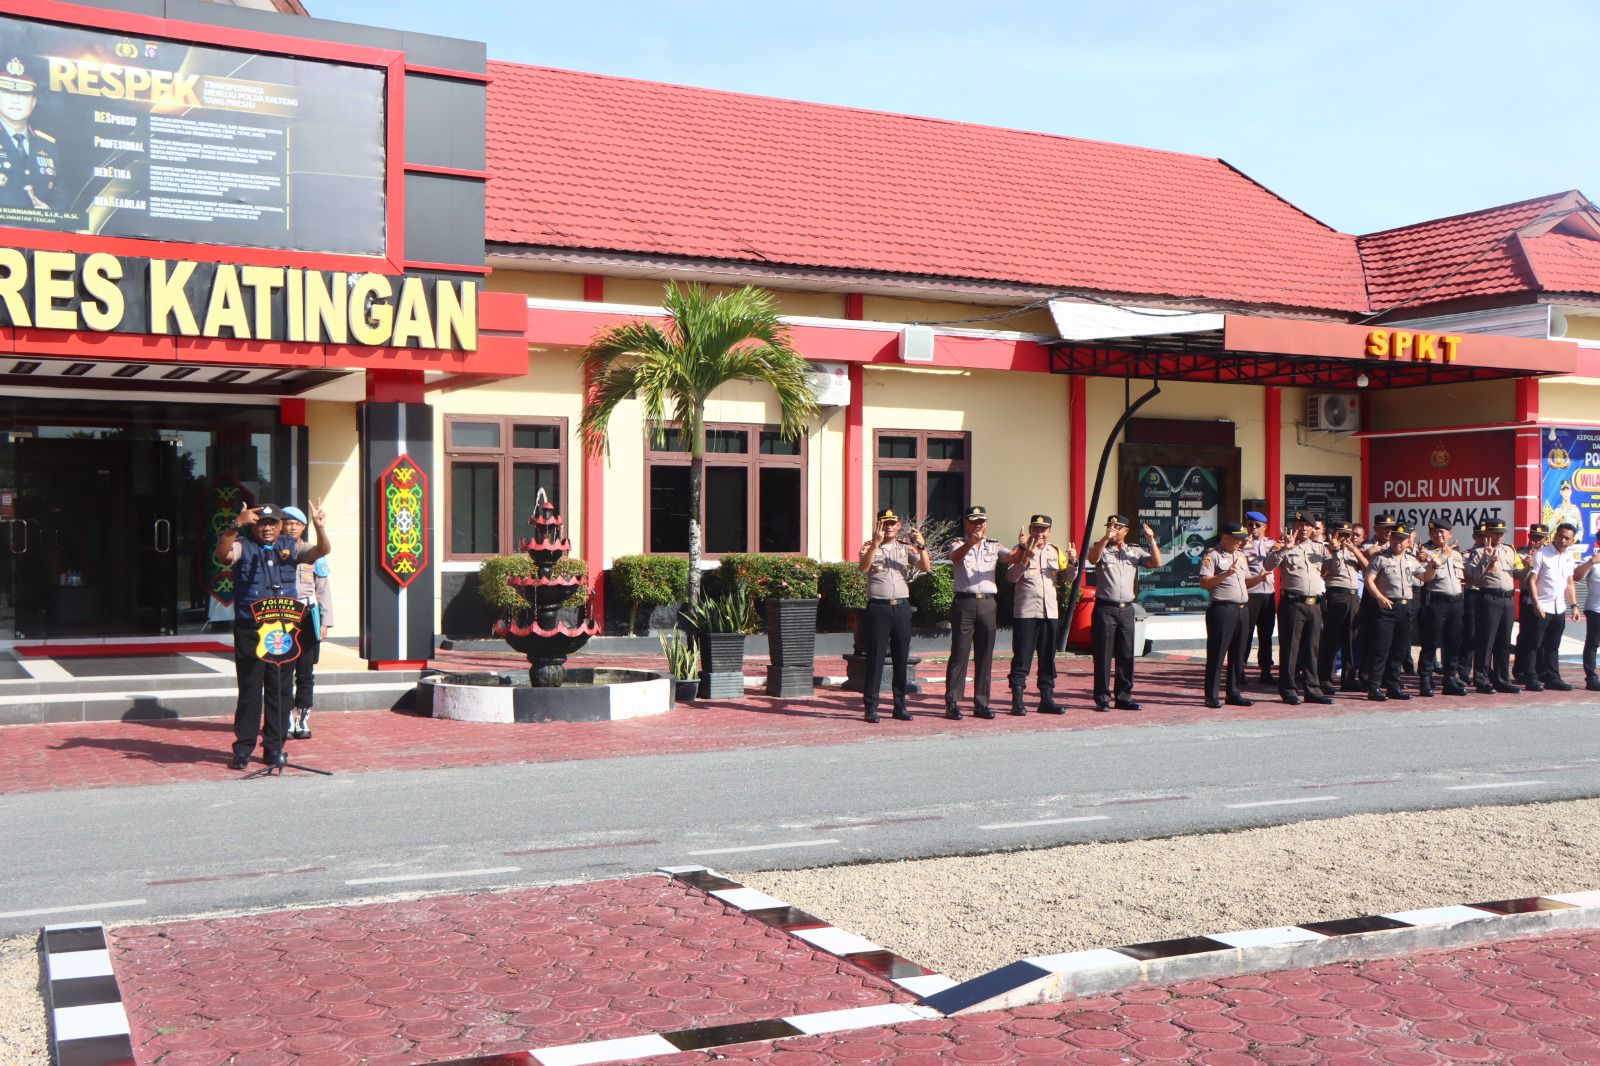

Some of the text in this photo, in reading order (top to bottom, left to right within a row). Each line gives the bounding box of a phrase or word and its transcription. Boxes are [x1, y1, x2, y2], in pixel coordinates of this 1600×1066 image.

[49, 57, 201, 107] RESPEK
[150, 257, 478, 352] KATINGAN
[1366, 329, 1463, 362] SPKT
[1383, 477, 1501, 498] POLRI UNTUK
